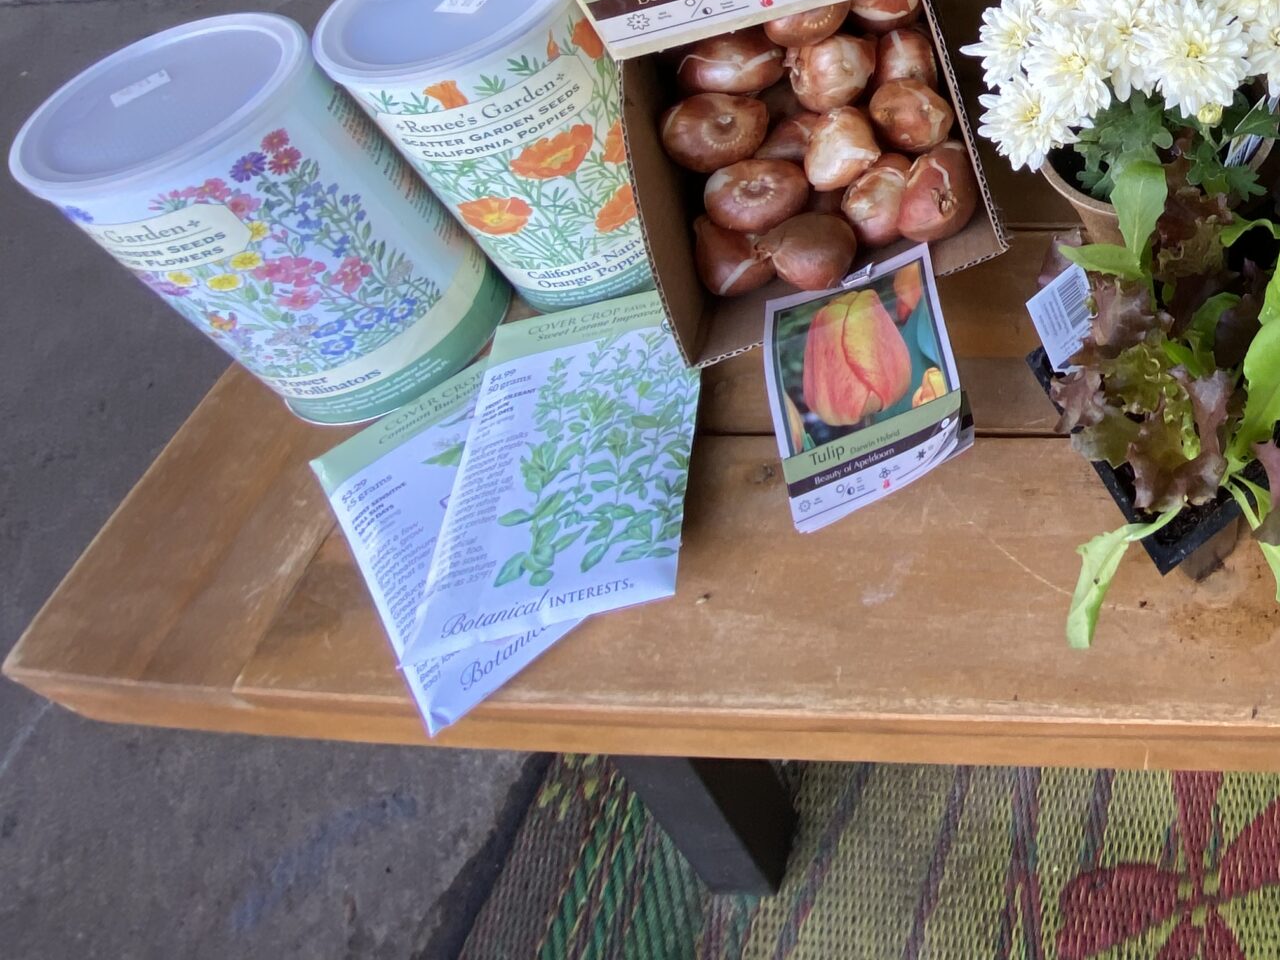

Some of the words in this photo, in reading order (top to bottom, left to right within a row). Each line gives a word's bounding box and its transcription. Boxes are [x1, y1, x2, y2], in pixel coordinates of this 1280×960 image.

[402, 113, 477, 134] Renee's
[481, 80, 556, 120] Garden
[469, 114, 535, 142] GARDEN
[538, 83, 580, 115] SEEDS
[422, 137, 513, 159] CALIFORNIA
[518, 103, 576, 138] POPPIES
[103, 224, 185, 244] Garden
[167, 231, 226, 253] SEEDS
[145, 246, 225, 267] FLOWERS
[527, 260, 600, 280] California
[537, 274, 593, 289] Orange
[528, 317, 577, 336] COVER
[580, 307, 621, 324] CROP
[280, 374, 329, 388] Power
[294, 369, 383, 396] Pollinators
[384, 397, 438, 432] COVER
[809, 444, 845, 466] Tulip
[876, 429, 900, 444] Hybrid
[814, 466, 842, 485] Beauty
[843, 463, 852, 473] of
[853, 447, 895, 470] Apeldoorn
[358, 474, 392, 501] grams
[440, 589, 550, 638] Botanical
